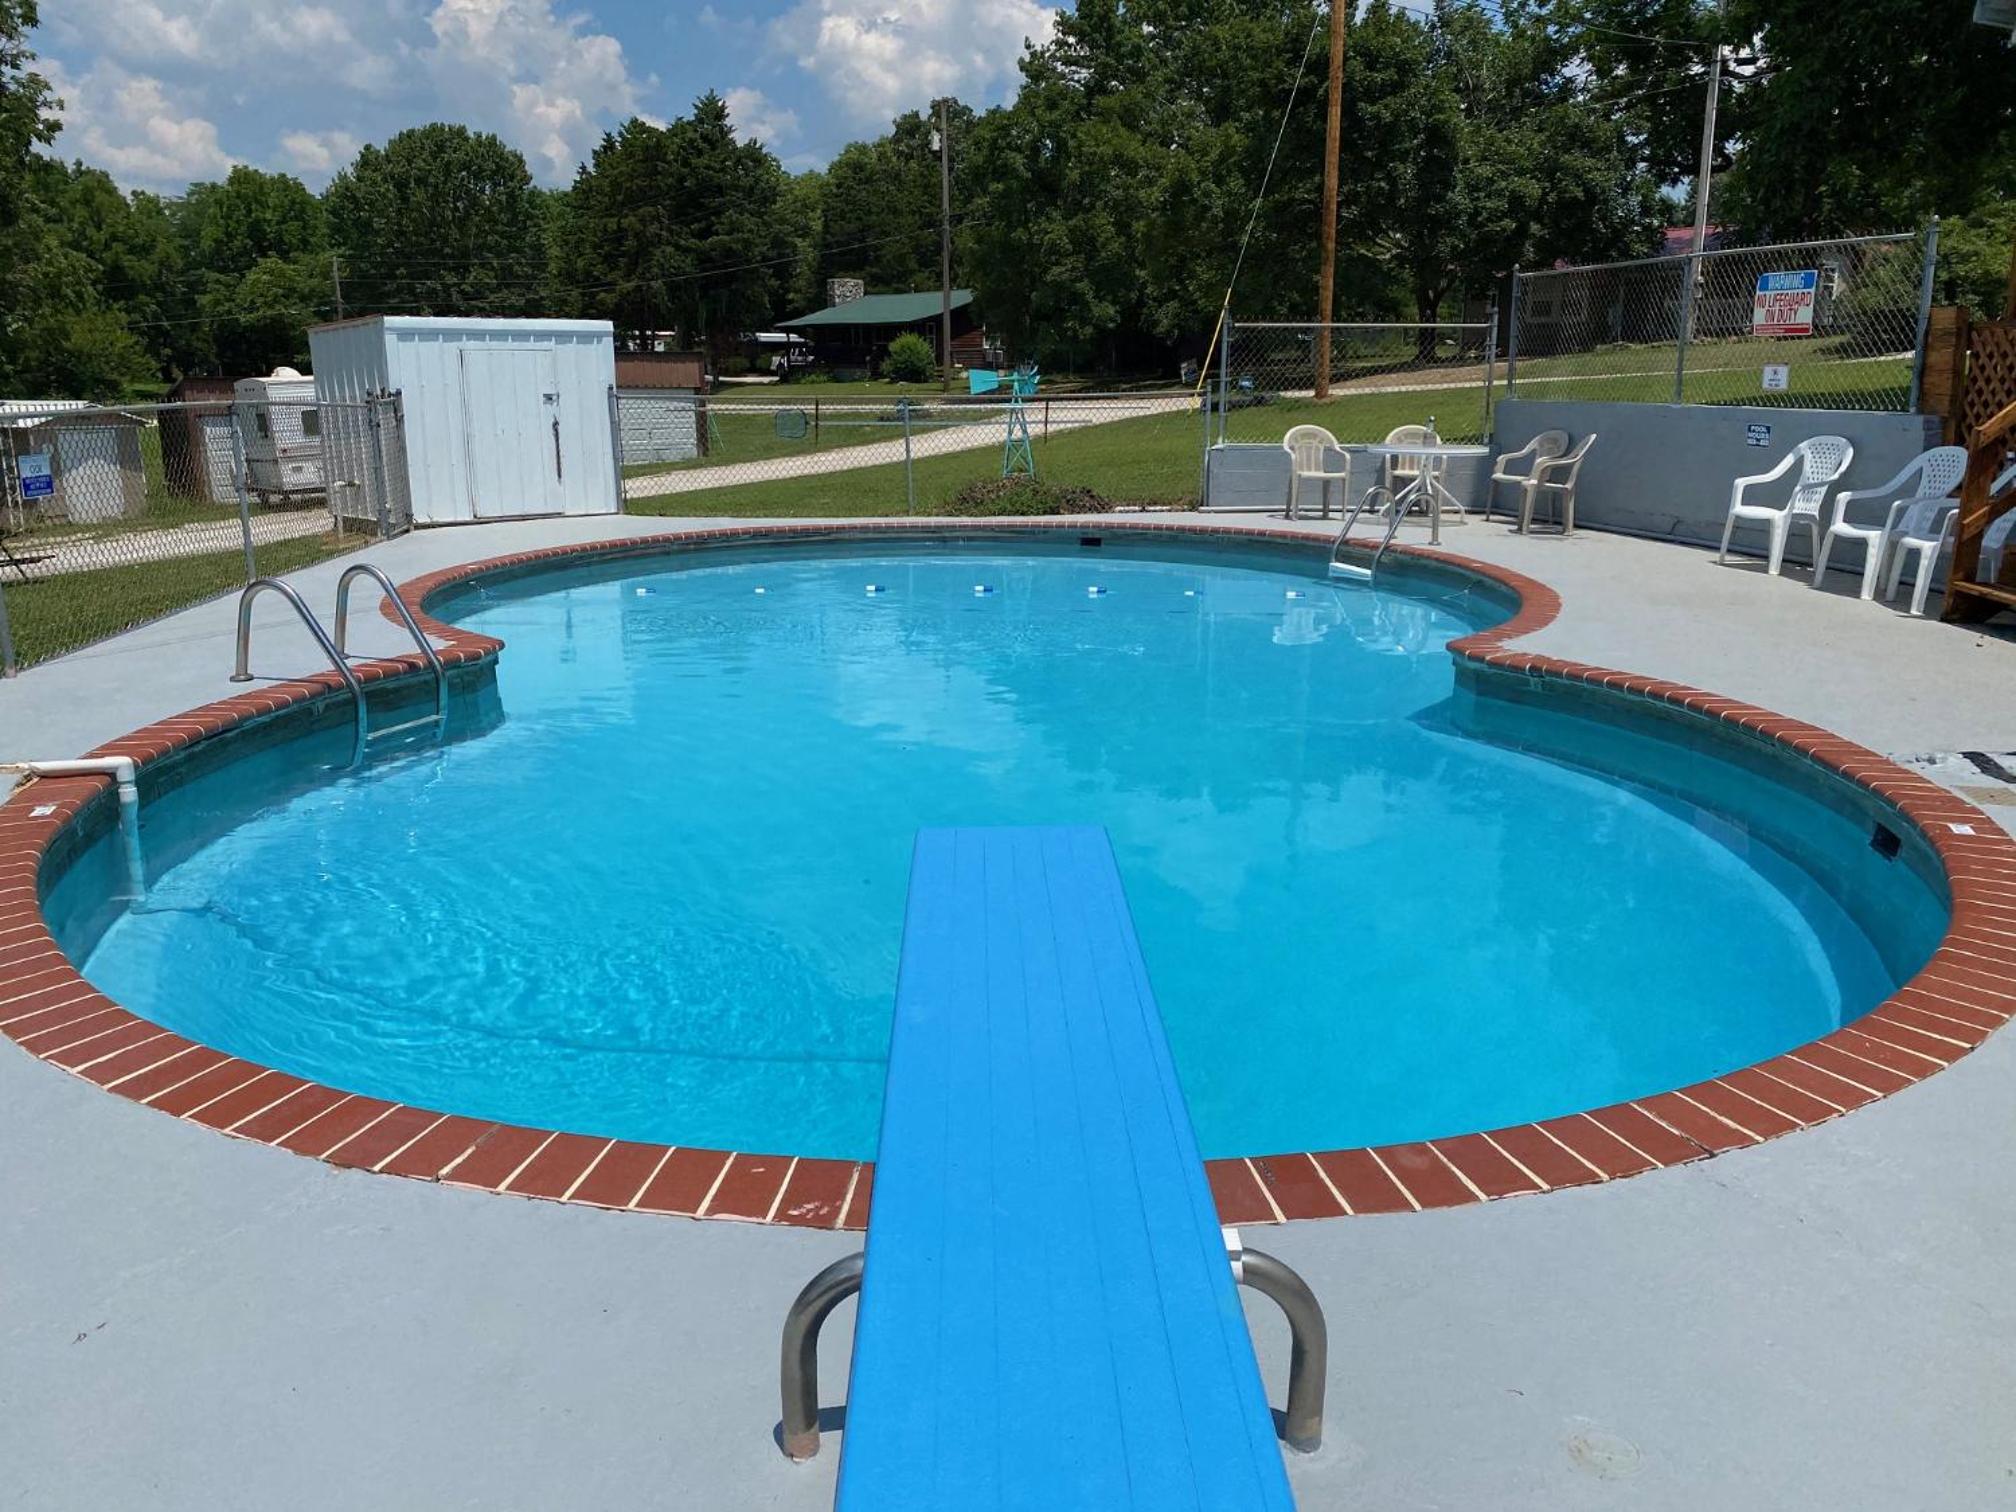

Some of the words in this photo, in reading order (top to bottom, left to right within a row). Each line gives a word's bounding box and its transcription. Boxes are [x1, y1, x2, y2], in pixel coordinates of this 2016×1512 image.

[1768, 273, 1805, 290] WARNING
[1757, 293, 1766, 308] NO
[1768, 291, 1812, 307] LIFEGUARD
[1765, 308, 1775, 323] ON
[1776, 307, 1799, 323] DUTY
